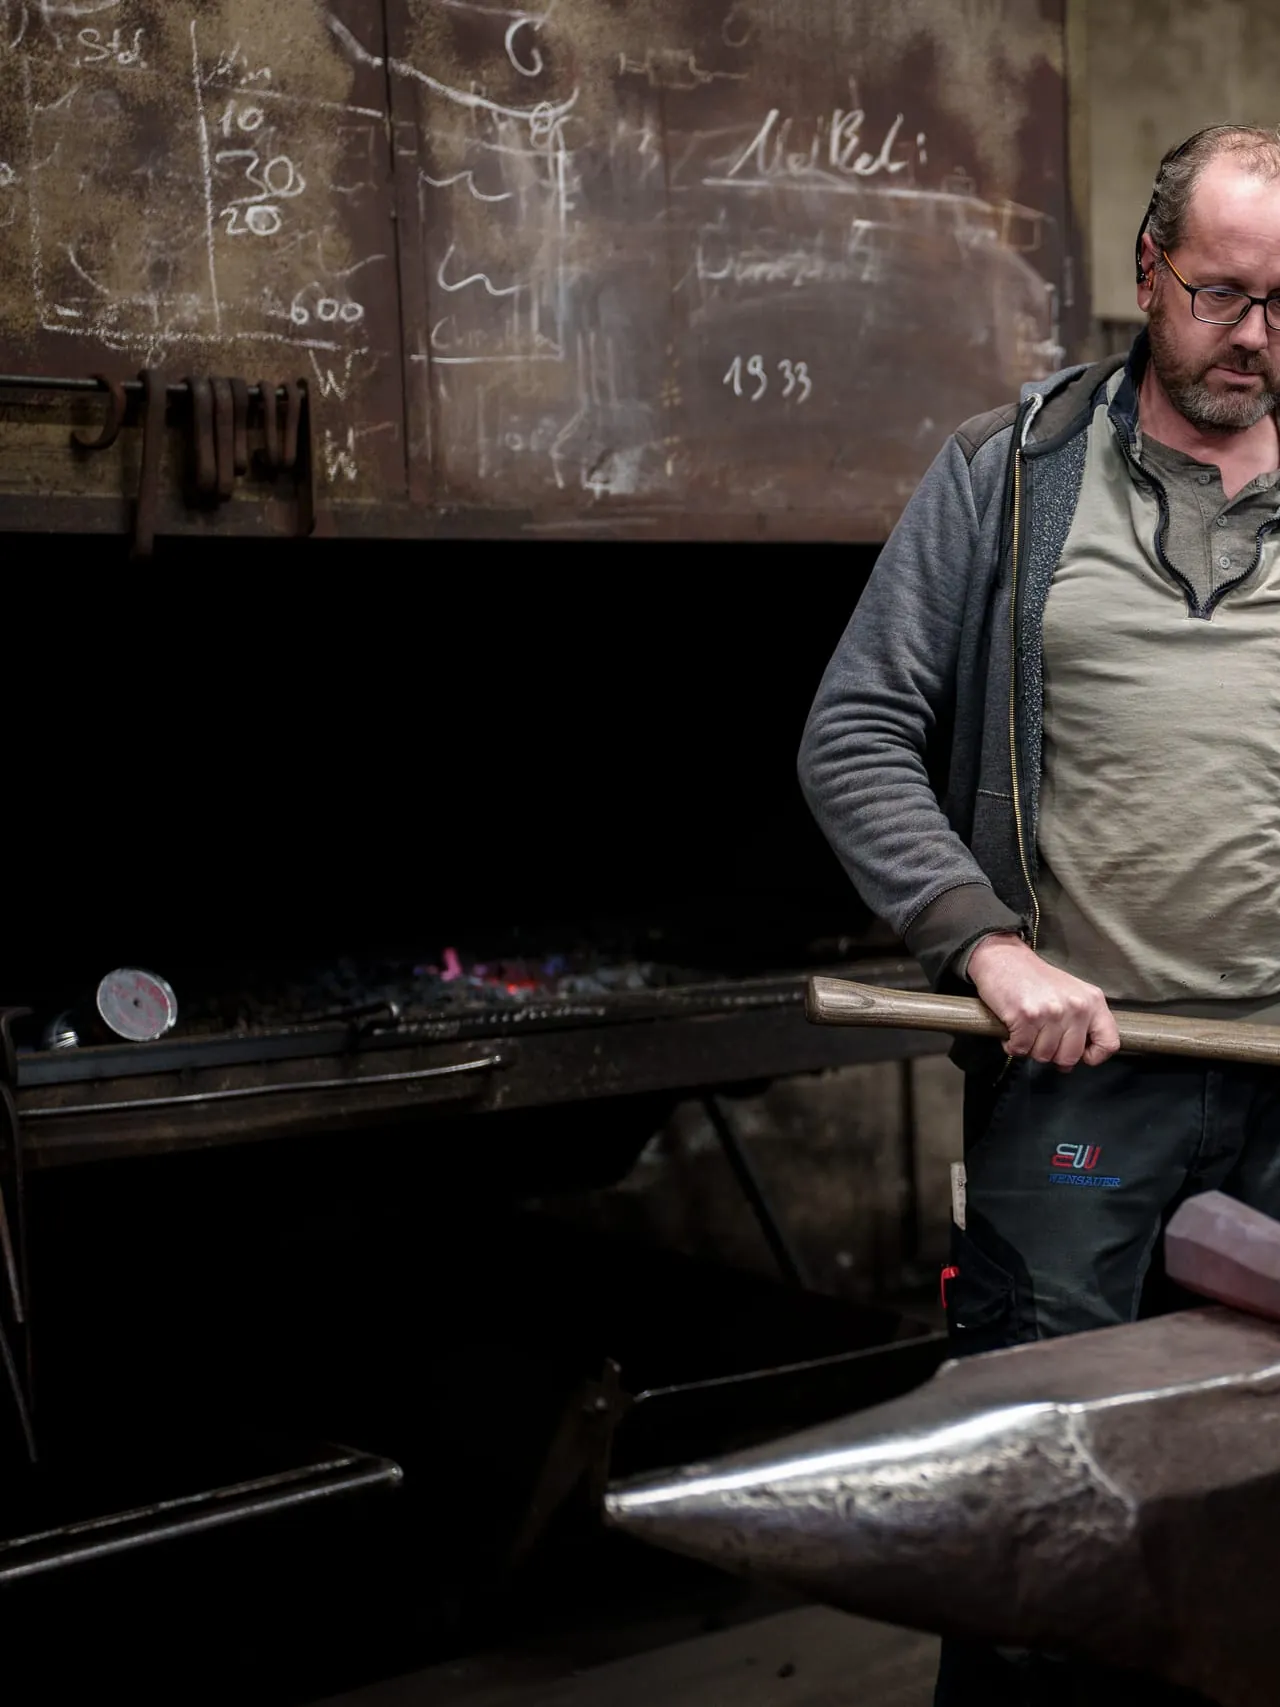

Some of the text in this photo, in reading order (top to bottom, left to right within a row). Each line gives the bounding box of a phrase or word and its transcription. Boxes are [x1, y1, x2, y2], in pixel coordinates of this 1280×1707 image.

[219, 99, 264, 138] 10
[220, 205, 282, 236] 20
[1048, 1173, 1121, 1188] WENSAUER
